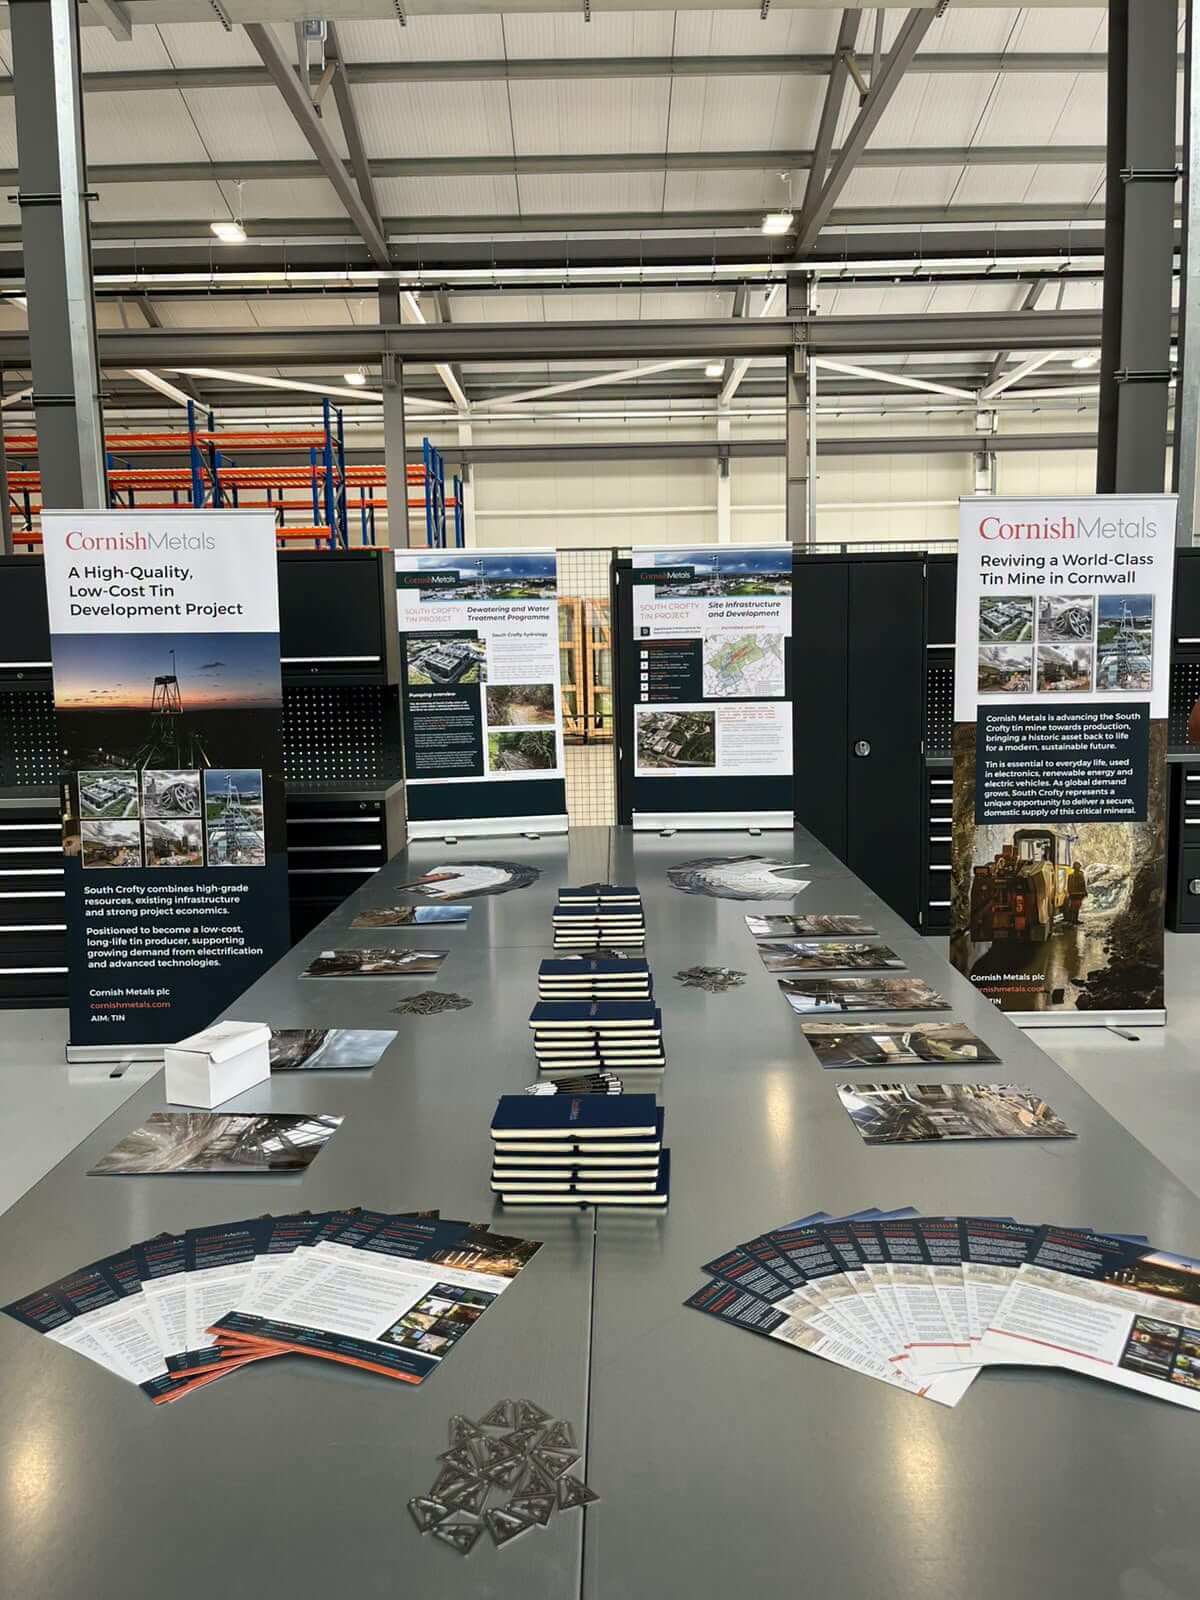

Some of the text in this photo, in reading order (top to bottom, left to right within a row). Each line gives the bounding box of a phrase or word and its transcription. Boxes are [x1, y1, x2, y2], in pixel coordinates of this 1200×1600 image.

[979, 516, 1157, 540] CornishMetals
[65, 531, 215, 550] CornishMetals
[981, 553, 1153, 568] Reviving a World-Class
[69, 566, 193, 580] A High-Quality,
[980, 571, 1135, 585] Tin Mine in Cornwall
[69, 585, 174, 597] Low-Cost Tin
[71, 603, 242, 618] Development Project
[1056, 714, 1098, 722] advancing
[986, 725, 1010, 733] Crofty
[986, 734, 1019, 743] bringing
[1056, 759, 1091, 768] everyday
[1087, 770, 1115, 778] energy
[1065, 779, 1090, 787] global
[1038, 789, 1064, 798] Crofty
[984, 799, 1011, 808] unique
[1013, 799, 1061, 808] opportunity
[1022, 808, 1049, 816] supply
[115, 886, 145, 894] Crofty
[147, 885, 194, 893] combines
[196, 884, 248, 894] high-grade
[136, 896, 172, 906] existing
[174, 896, 240, 904] infrastructure
[106, 908, 138, 918] strong
[140, 907, 173, 917] project
[86, 926, 138, 936] Positioned
[87, 937, 127, 947] long-life
[192, 936, 244, 947] supporting
[88, 947, 263, 958] growing demand from electrification
[88, 960, 107, 968] and
[109, 959, 155, 968] advanced
[1032, 973, 1045, 982] plc
[90, 988, 170, 998] Cornish Metals plc
